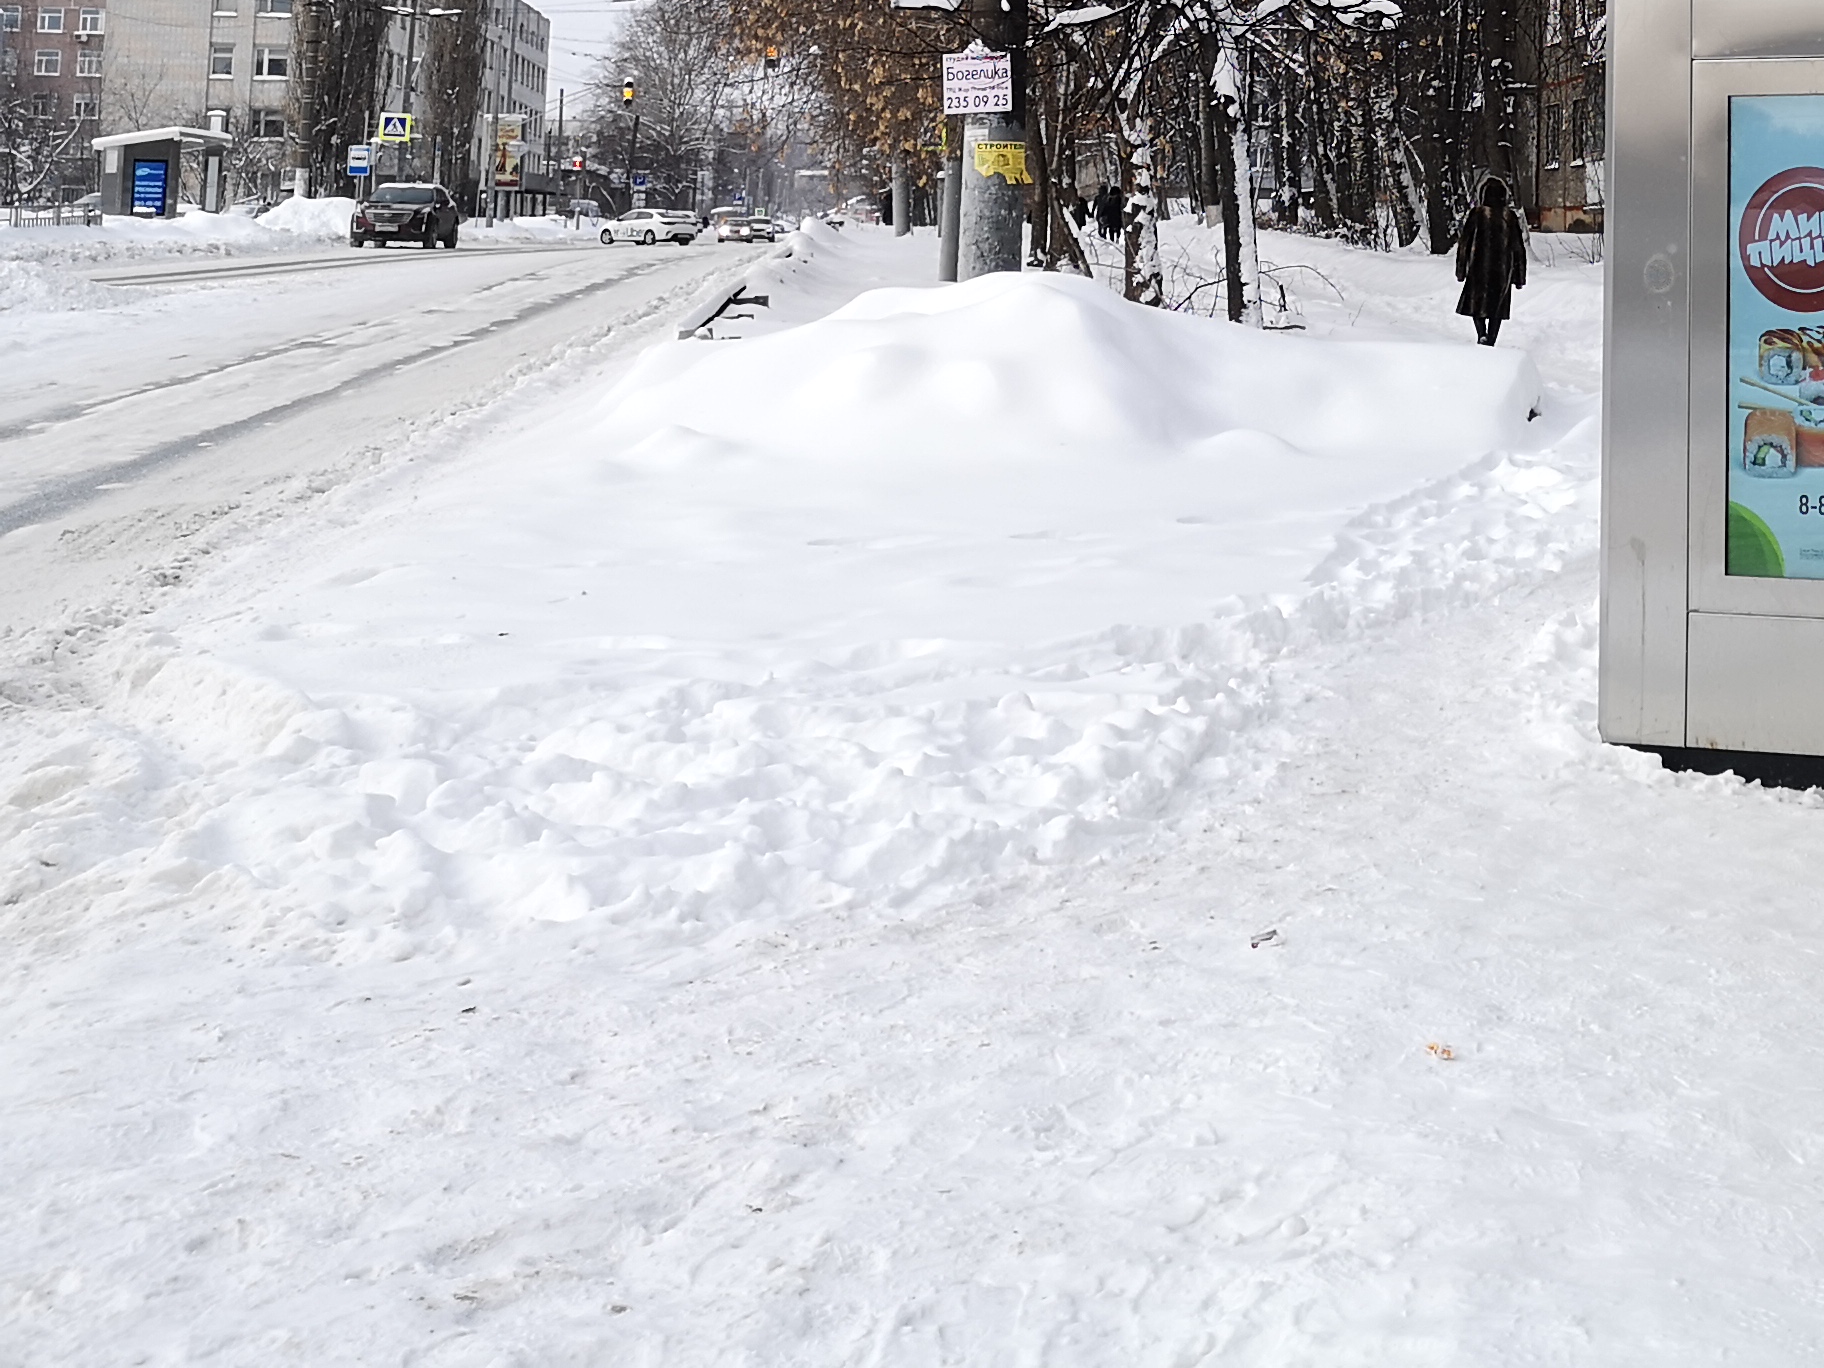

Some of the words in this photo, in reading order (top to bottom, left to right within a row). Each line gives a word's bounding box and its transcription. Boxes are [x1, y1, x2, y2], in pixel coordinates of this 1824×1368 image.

[946, 66, 1009, 82] Богелика
[947, 96, 969, 109] 235
[973, 95, 989, 107] 09
[993, 94, 1008, 107] 25
